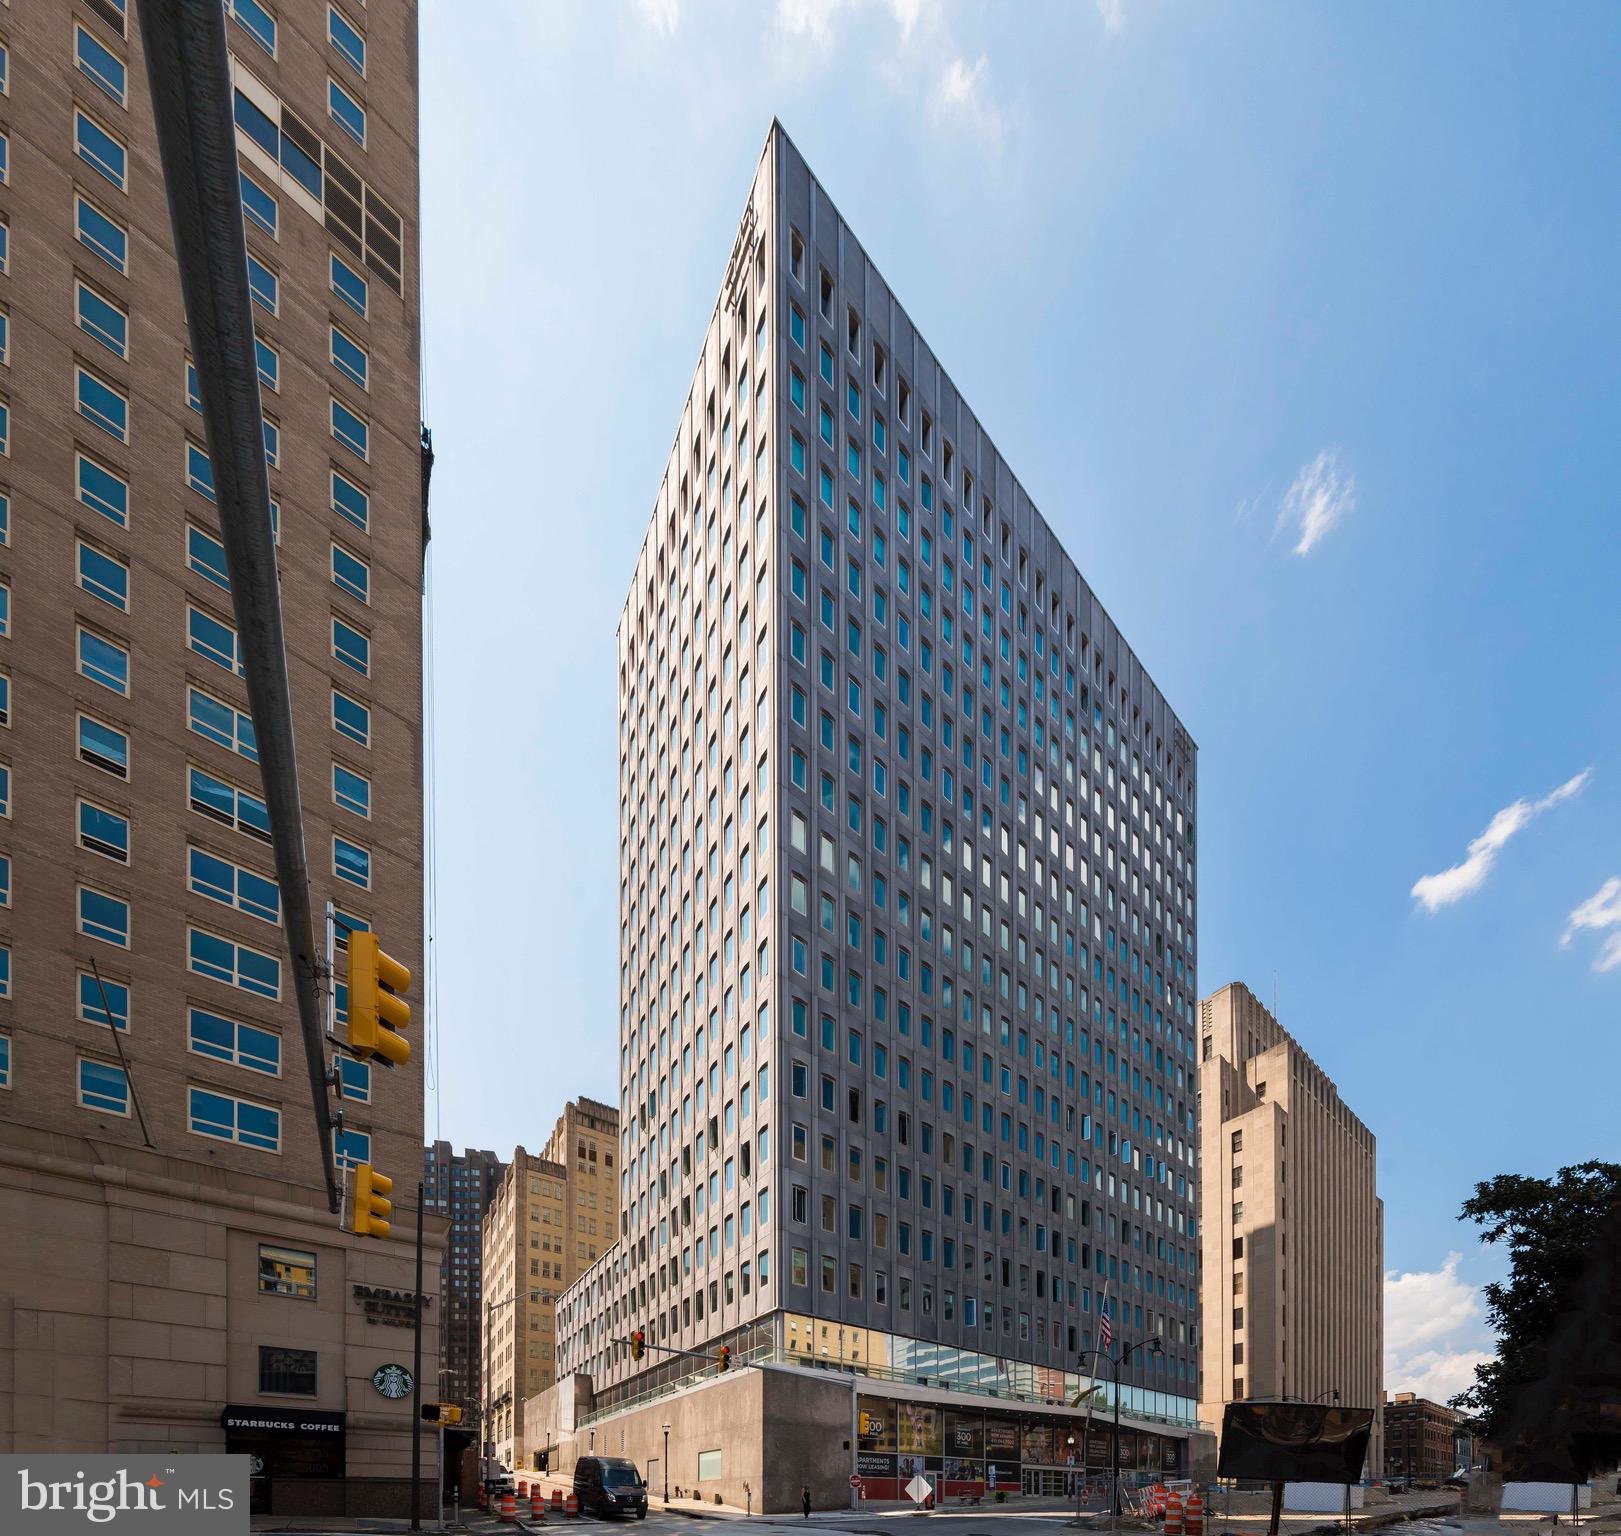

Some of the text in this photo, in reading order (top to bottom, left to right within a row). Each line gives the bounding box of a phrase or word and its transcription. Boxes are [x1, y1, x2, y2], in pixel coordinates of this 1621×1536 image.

[227, 1419, 340, 1432] STARBUCKS COFFEE
[956, 1431, 972, 1442] 300
